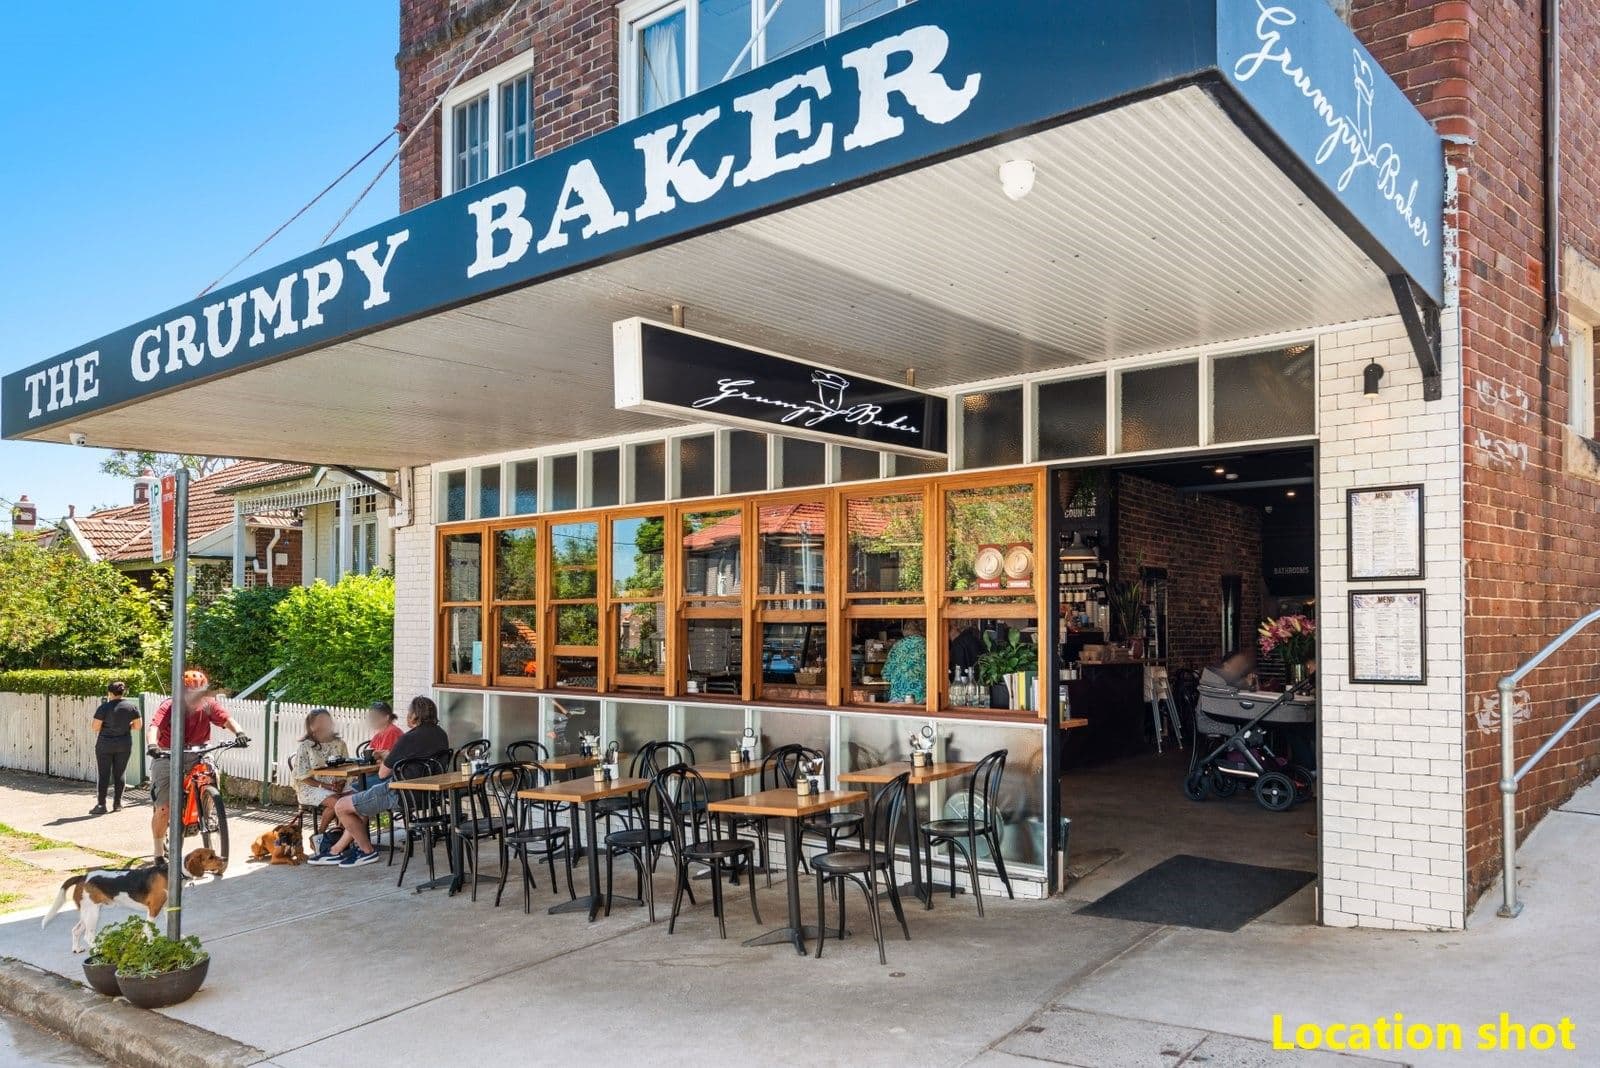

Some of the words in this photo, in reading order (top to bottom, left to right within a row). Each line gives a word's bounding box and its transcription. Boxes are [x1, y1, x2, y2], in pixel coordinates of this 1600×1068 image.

[1234, 0, 1374, 191] Grumpy
[1376, 143, 1430, 247] Baker
[25, 351, 100, 419] THE
[130, 230, 410, 382] GRUMPY
[467, 25, 982, 279] BAKER
[692, 378, 843, 427] Grumpy
[846, 403, 920, 433] Baker
[1273, 566, 1310, 575] BATHROOMS
[1377, 595, 1396, 604] MENU
